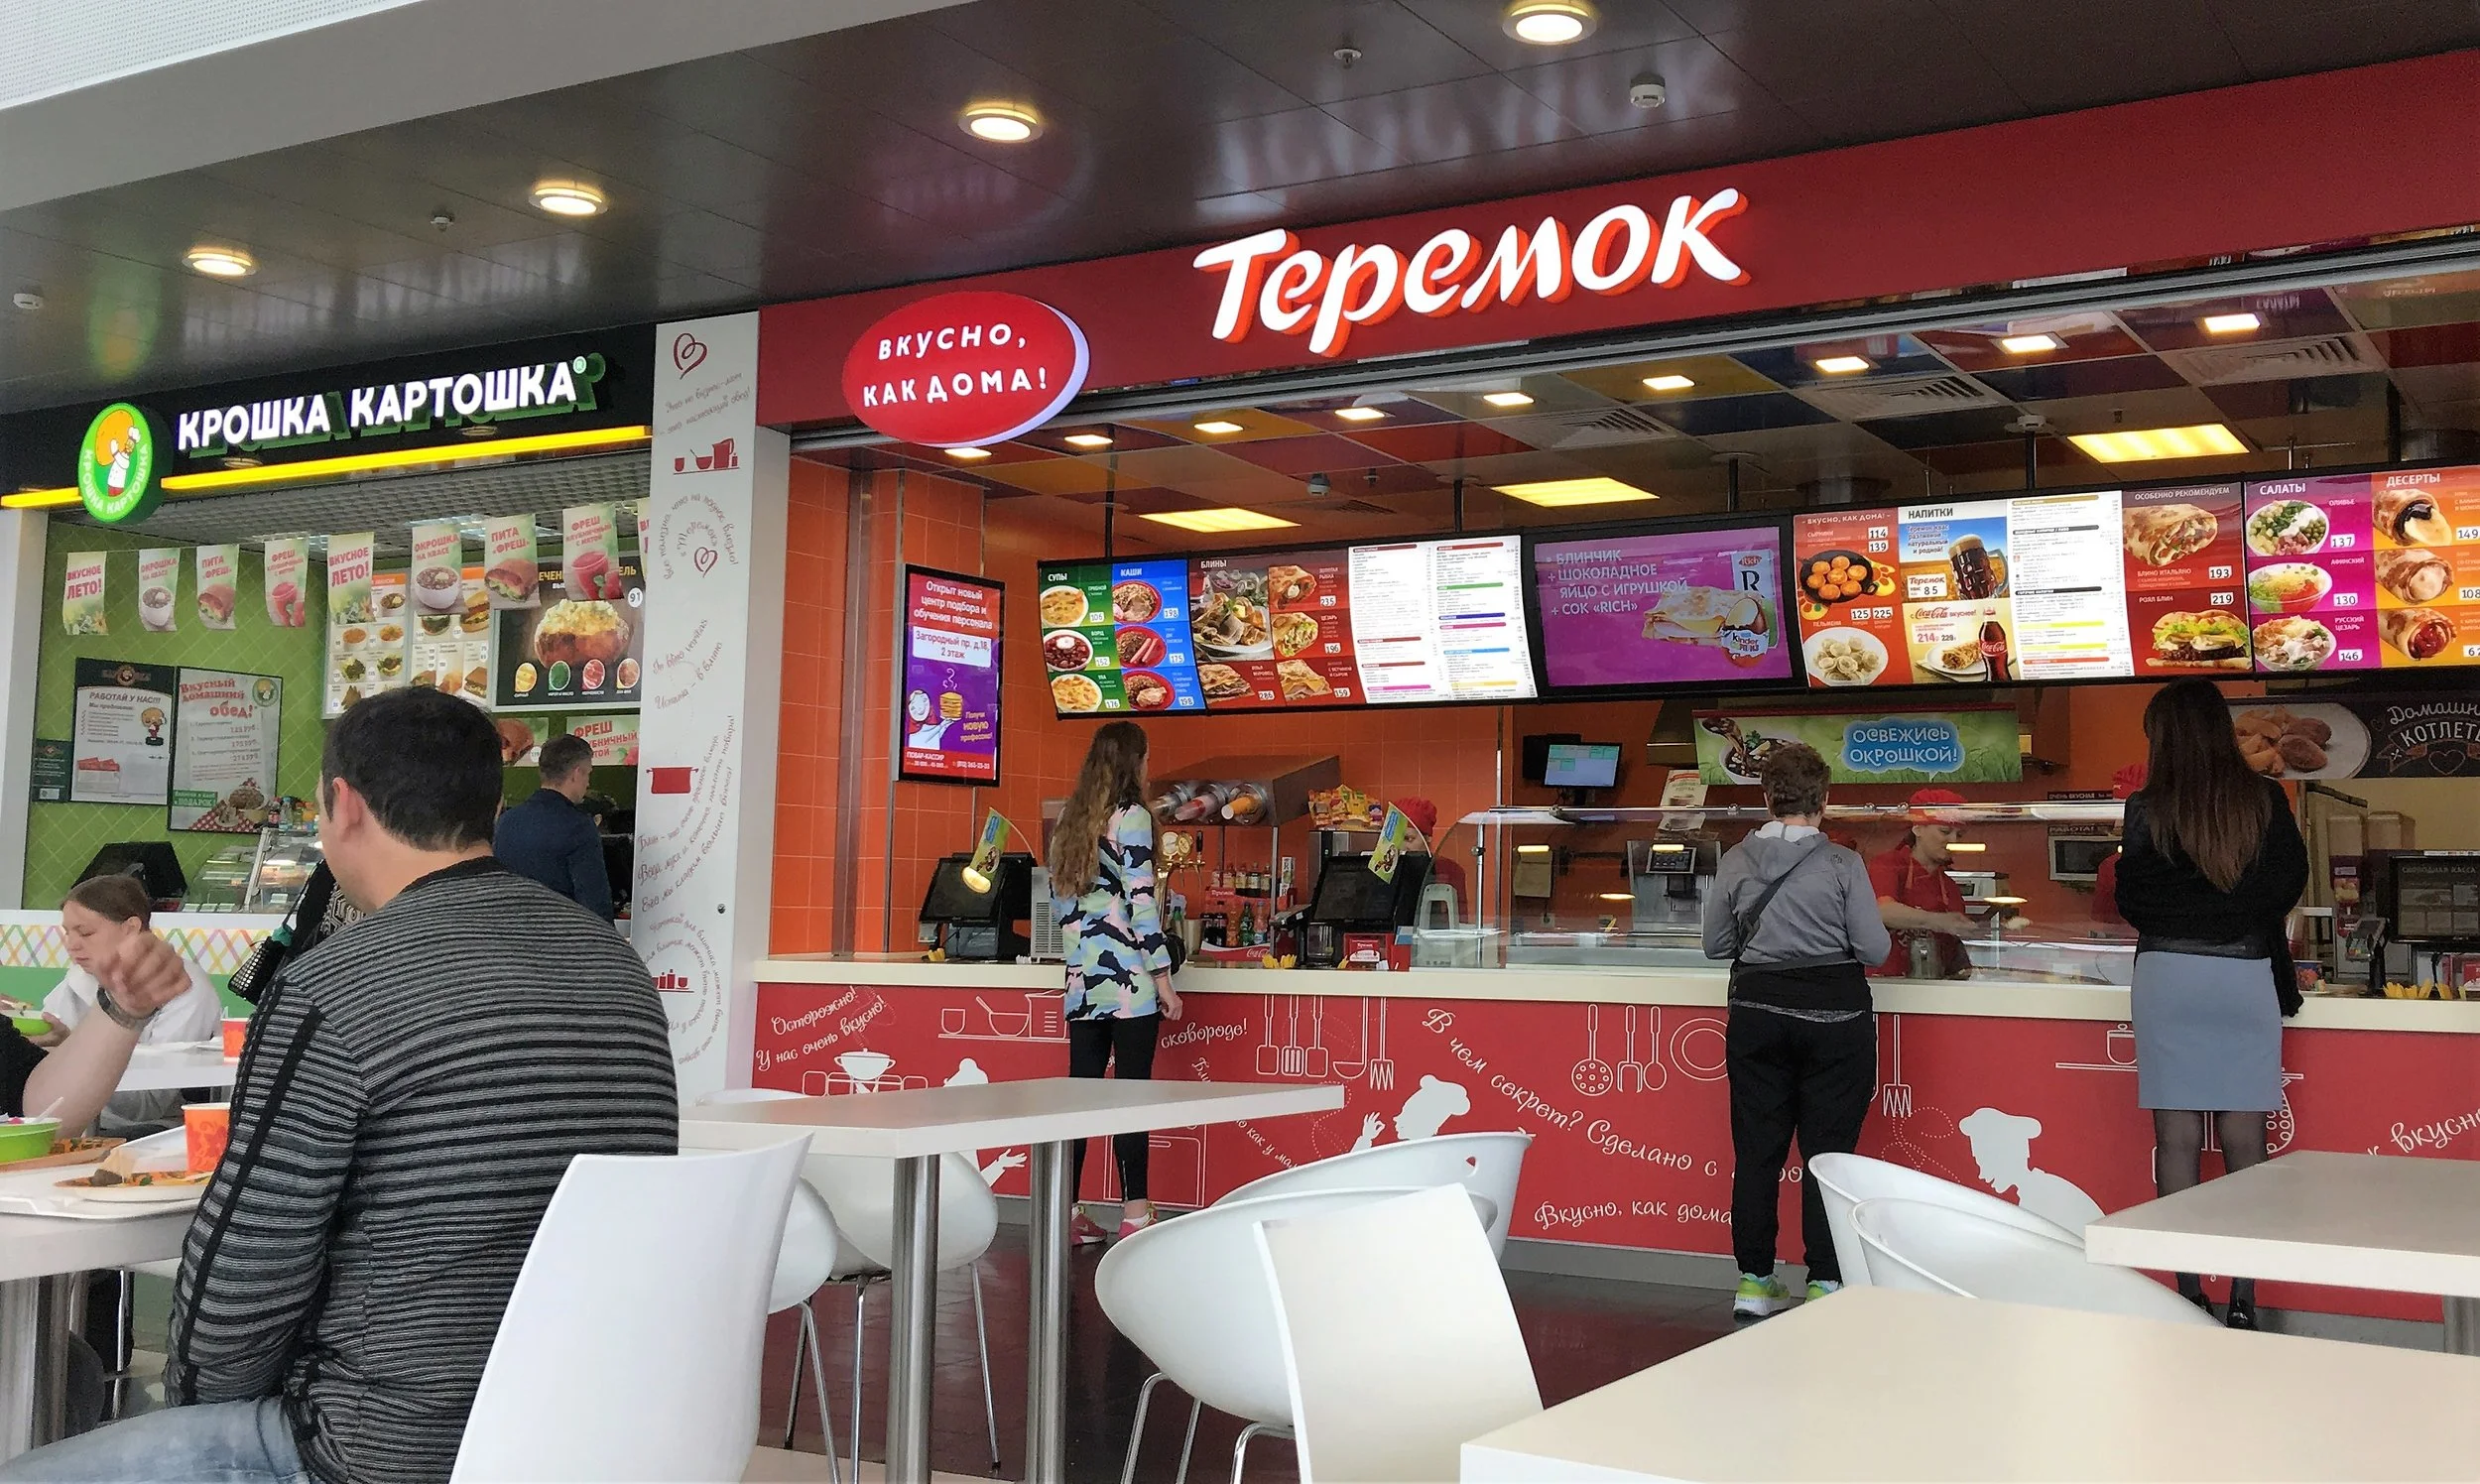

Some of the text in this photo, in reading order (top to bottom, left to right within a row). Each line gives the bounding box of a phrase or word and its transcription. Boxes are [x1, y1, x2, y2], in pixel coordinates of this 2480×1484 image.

[1193, 186, 1741, 357] Теремок
[877, 323, 1028, 361] ВКУСНО,
[862, 366, 1049, 409] КАК ДОМА!
[179, 360, 578, 451] КРОШКА КАРТОШКА
[82, 442, 150, 515] КРОШКА КАРТОШКА
[2386, 473, 2440, 488] ДЕСЕРТЫ
[2135, 487, 2230, 501] ОСОБЕННО РЕКОМЕНДУЕМ
[2260, 482, 2306, 495] САЛАТЫ
[1807, 517, 1841, 526] ВКУСНО,
[1842, 514, 1858, 523] КАК
[1908, 508, 1953, 519] НАПИТКИ
[571, 516, 601, 532] ФРЕШ
[491, 527, 521, 546] ПИТА
[1869, 529, 1887, 539] 114
[2458, 529, 2479, 541] 149
[415, 533, 461, 553] ОКРОШКА
[1869, 542, 1887, 553] 139
[2332, 537, 2353, 548] 137
[201, 556, 225, 569] ПИТА
[272, 550, 297, 562] ФРЕШ
[328, 547, 370, 567] ВКУСНОЕ
[1555, 549, 1622, 565] БЛИНЧИК
[1200, 559, 1227, 569] БЛИНЫ
[66, 564, 102, 582] ВКУСНОЕ
[331, 560, 370, 587] ЛЕТО!
[1048, 573, 1068, 582] СУПЫ
[1120, 568, 1143, 577] КАШИ
[1558, 563, 1658, 581] ШОКОЛАДНОЕ
[2210, 568, 2230, 578] 193
[1910, 576, 1945, 585] Теремок
[66, 577, 103, 601] ЛЕТО!
[926, 580, 983, 601] Открыт новый
[1559, 576, 1688, 600] ЯЙЦО С ИГРУШКОЙ
[630, 592, 642, 603] 91
[2212, 594, 2232, 604] 219
[2336, 595, 2356, 605] 130
[921, 596, 945, 611] центр
[945, 600, 980, 617] подбора
[1562, 600, 1639, 615] СОК «RICH»
[914, 609, 993, 630] обучения персонала
[1852, 610, 1869, 619] 125
[1874, 609, 1892, 619] 225
[2334, 615, 2365, 624] РУССКИЙ
[2334, 623, 2361, 632] ЦЕЗАРЬ
[915, 630, 960, 648] Загородный
[940, 647, 965, 660] 2 этаж
[1171, 654, 1184, 664] 175
[2340, 652, 2359, 662] 146
[180, 679, 236, 693] Вкусный
[89, 692, 129, 702] РАБОТАЙ
[182, 690, 246, 703] домашний
[574, 721, 613, 739] ФРЕШ
[963, 721, 989, 733] новую
[1853, 725, 1950, 746] ОСВЕЖИСЬ
[1849, 746, 1958, 768] ОКРОШКОЙ!
[770, 985, 857, 1036] Осторожно!
[756, 995, 887, 1072] У нас очень вкусно!
[1422, 1008, 1718, 1177] В чем секрет? Сделано с
[1246, 1126, 1264, 1148] как
[1534, 1199, 1623, 1231] Вкусно,
[1631, 1198, 1669, 1218] как
